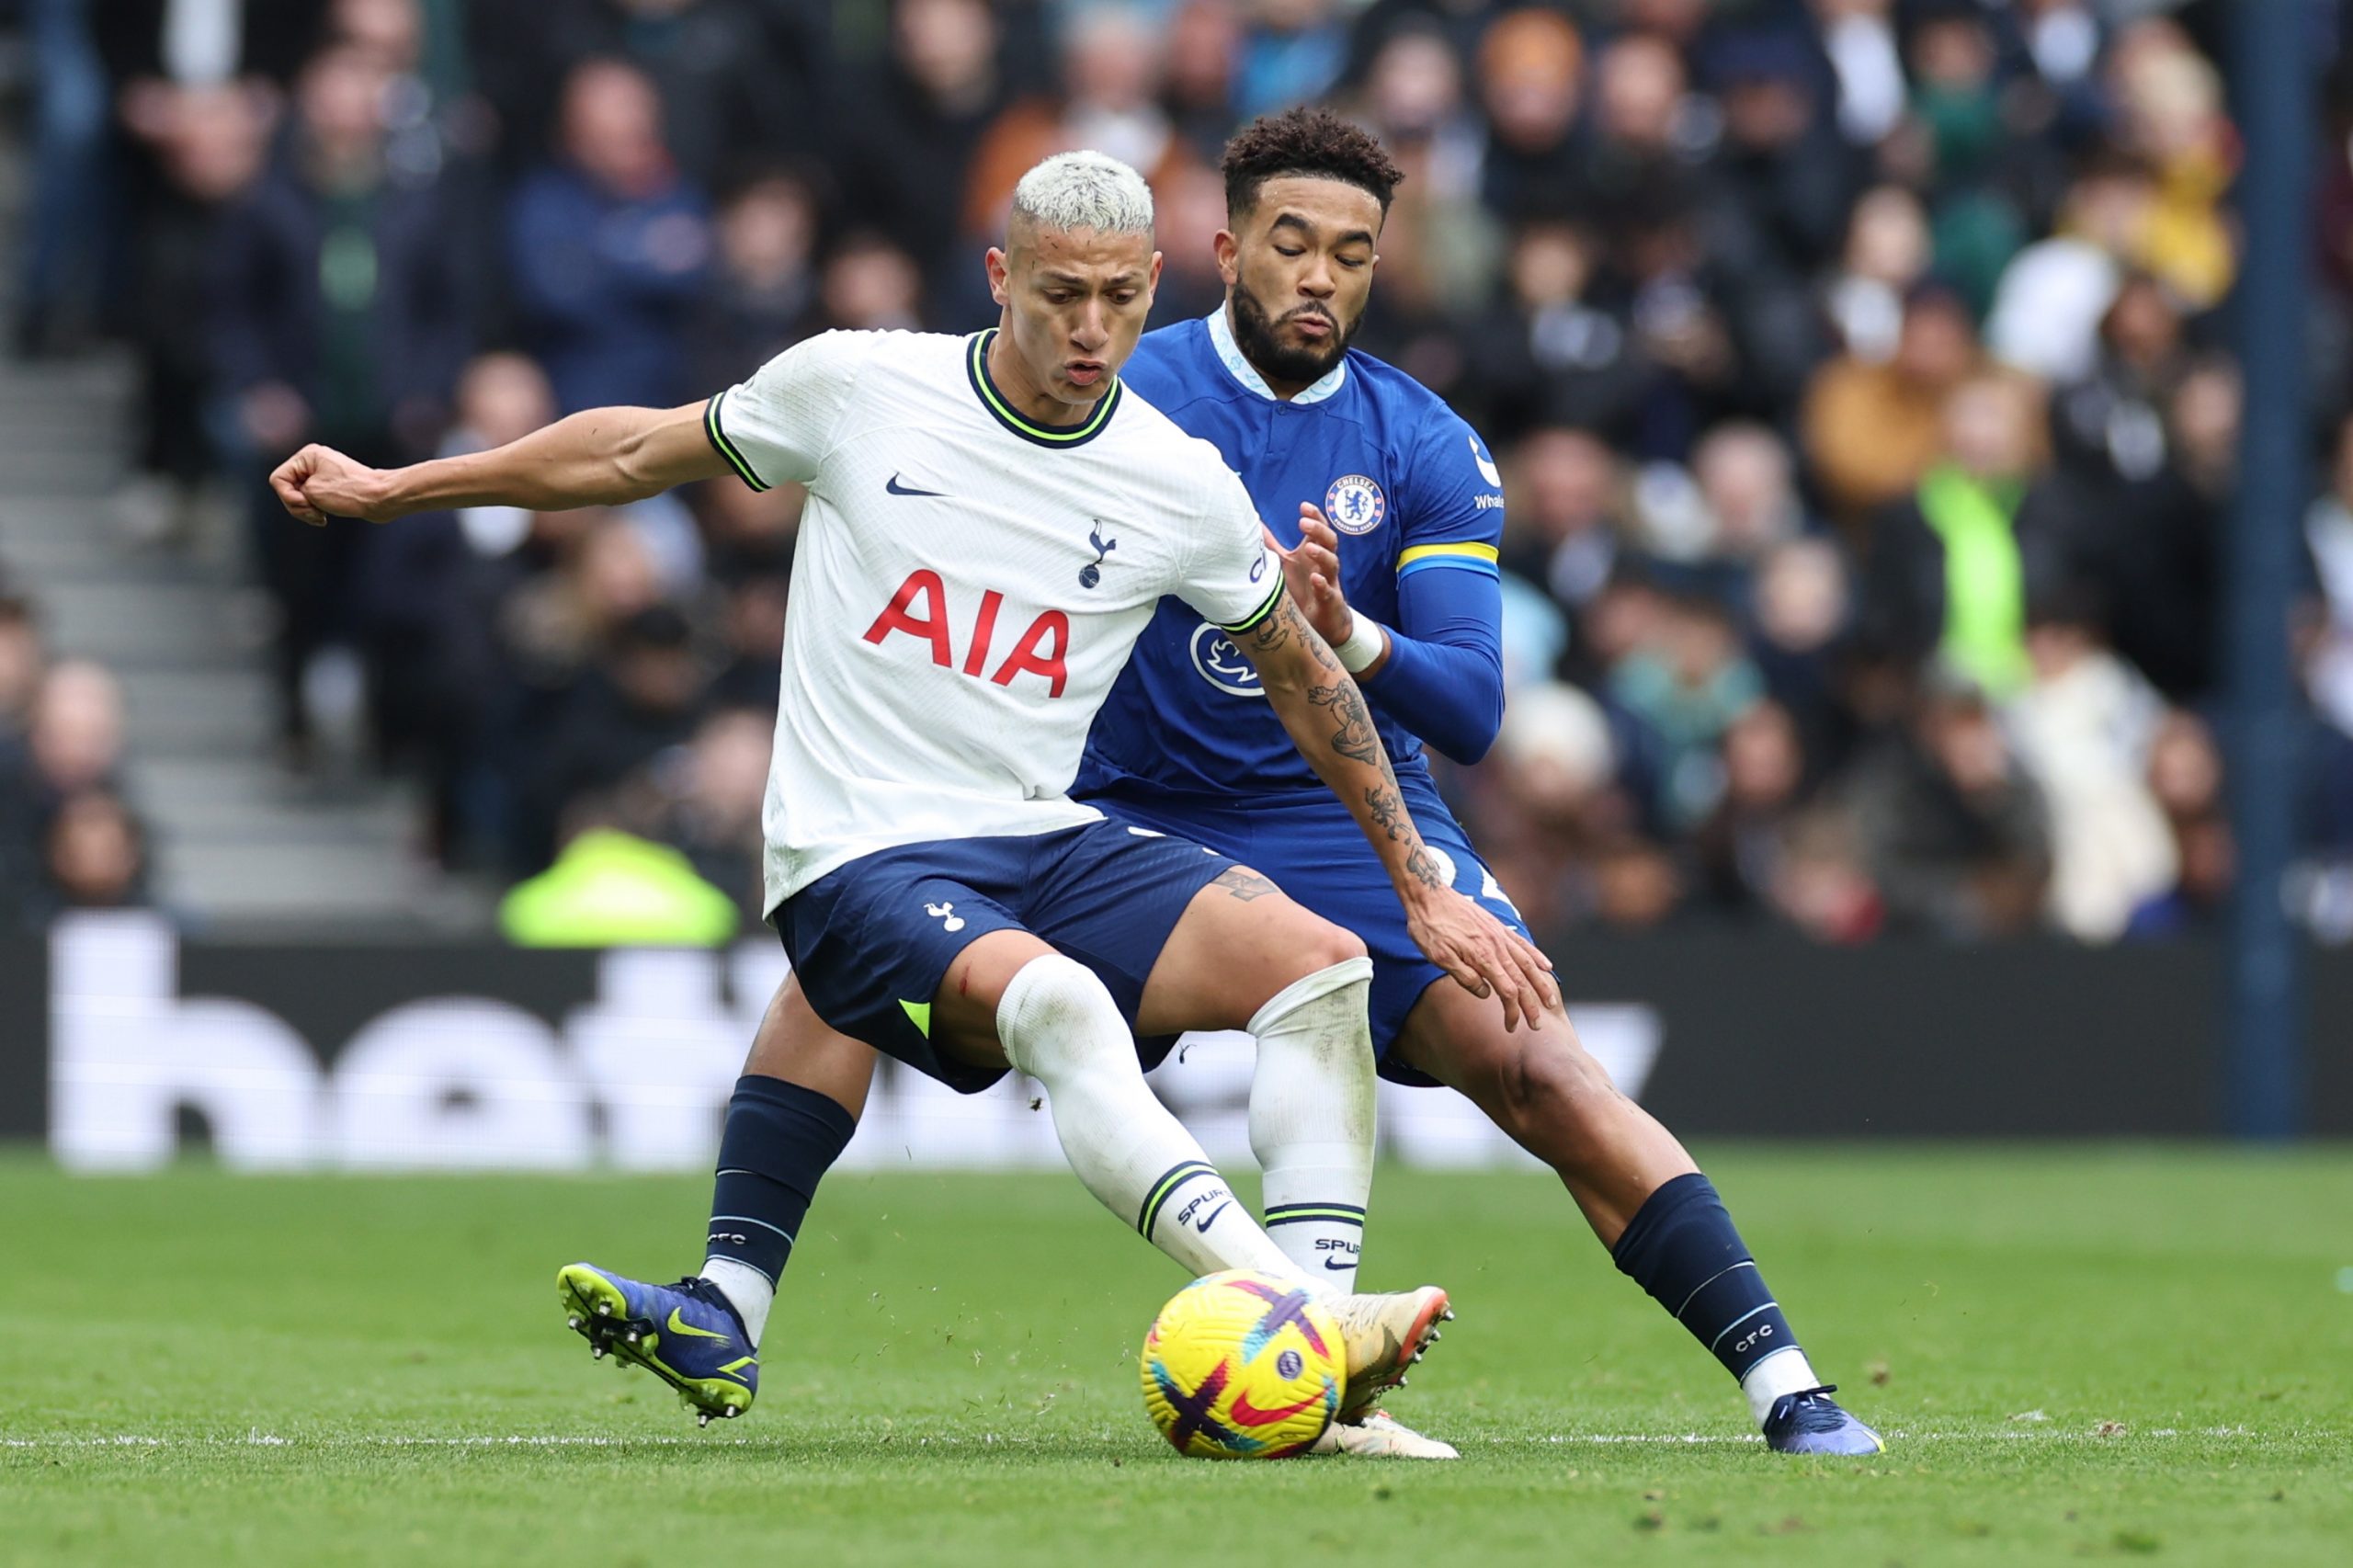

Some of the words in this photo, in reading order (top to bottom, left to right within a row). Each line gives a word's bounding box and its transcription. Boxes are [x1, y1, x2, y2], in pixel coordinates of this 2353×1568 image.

[1336, 477, 1375, 493] CHELSEA
[862, 568, 1069, 699] AIA
[1734, 1324, 1774, 1353] CFC
